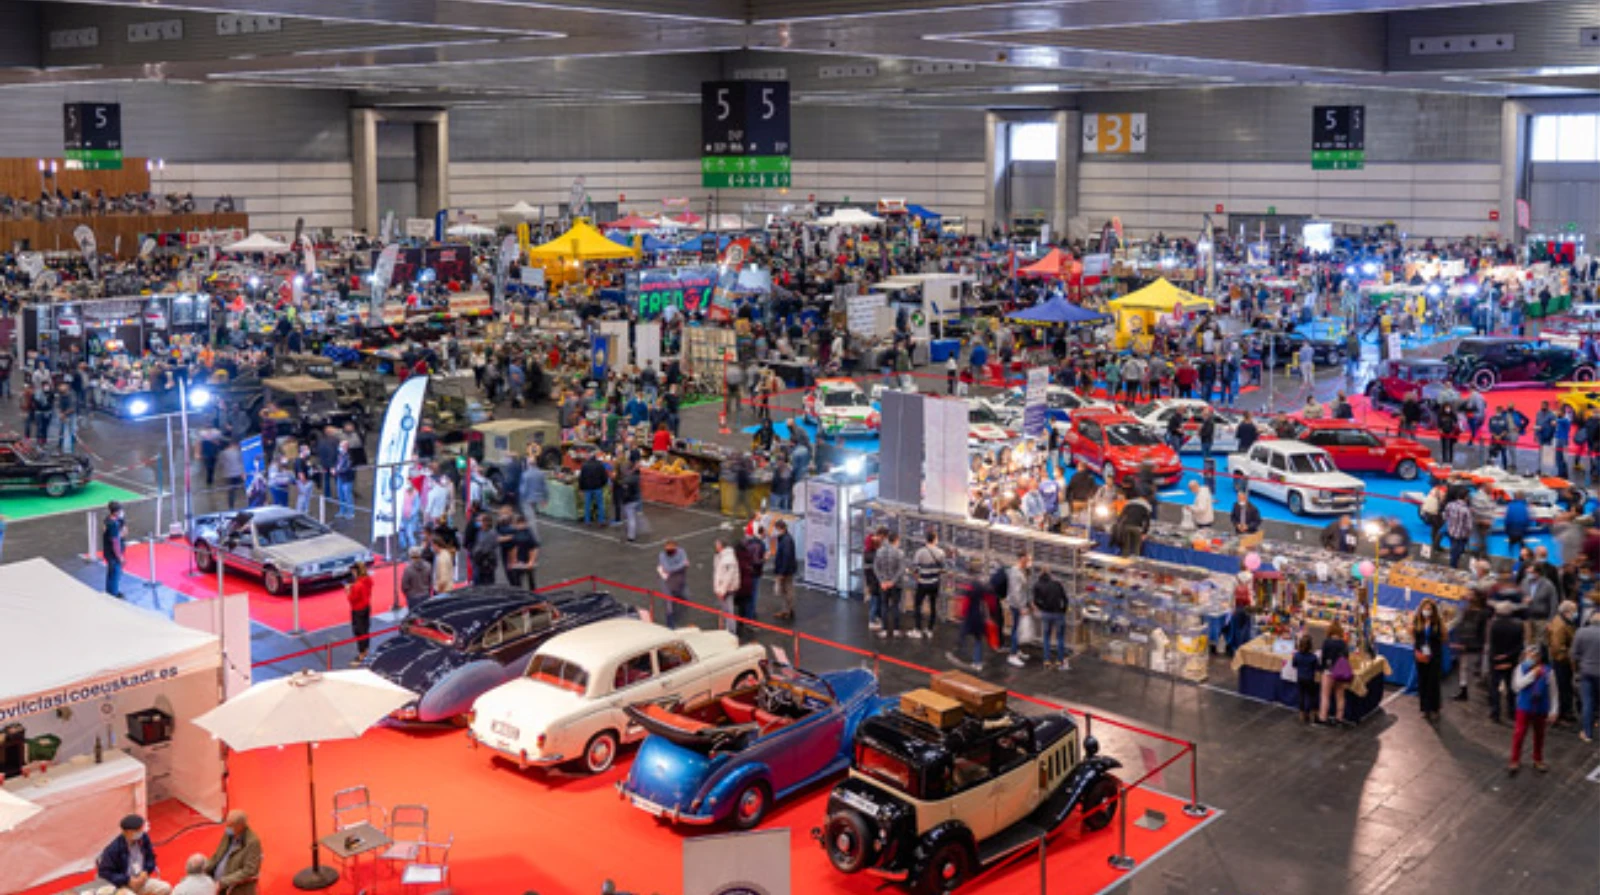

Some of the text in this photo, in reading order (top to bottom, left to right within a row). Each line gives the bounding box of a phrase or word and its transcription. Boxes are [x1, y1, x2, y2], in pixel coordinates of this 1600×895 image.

[95, 107, 107, 128] 5
[717, 88, 730, 120] 5
[762, 88, 775, 120] 5
[1325, 110, 1338, 130] 5
[1105, 115, 1123, 151] 3
